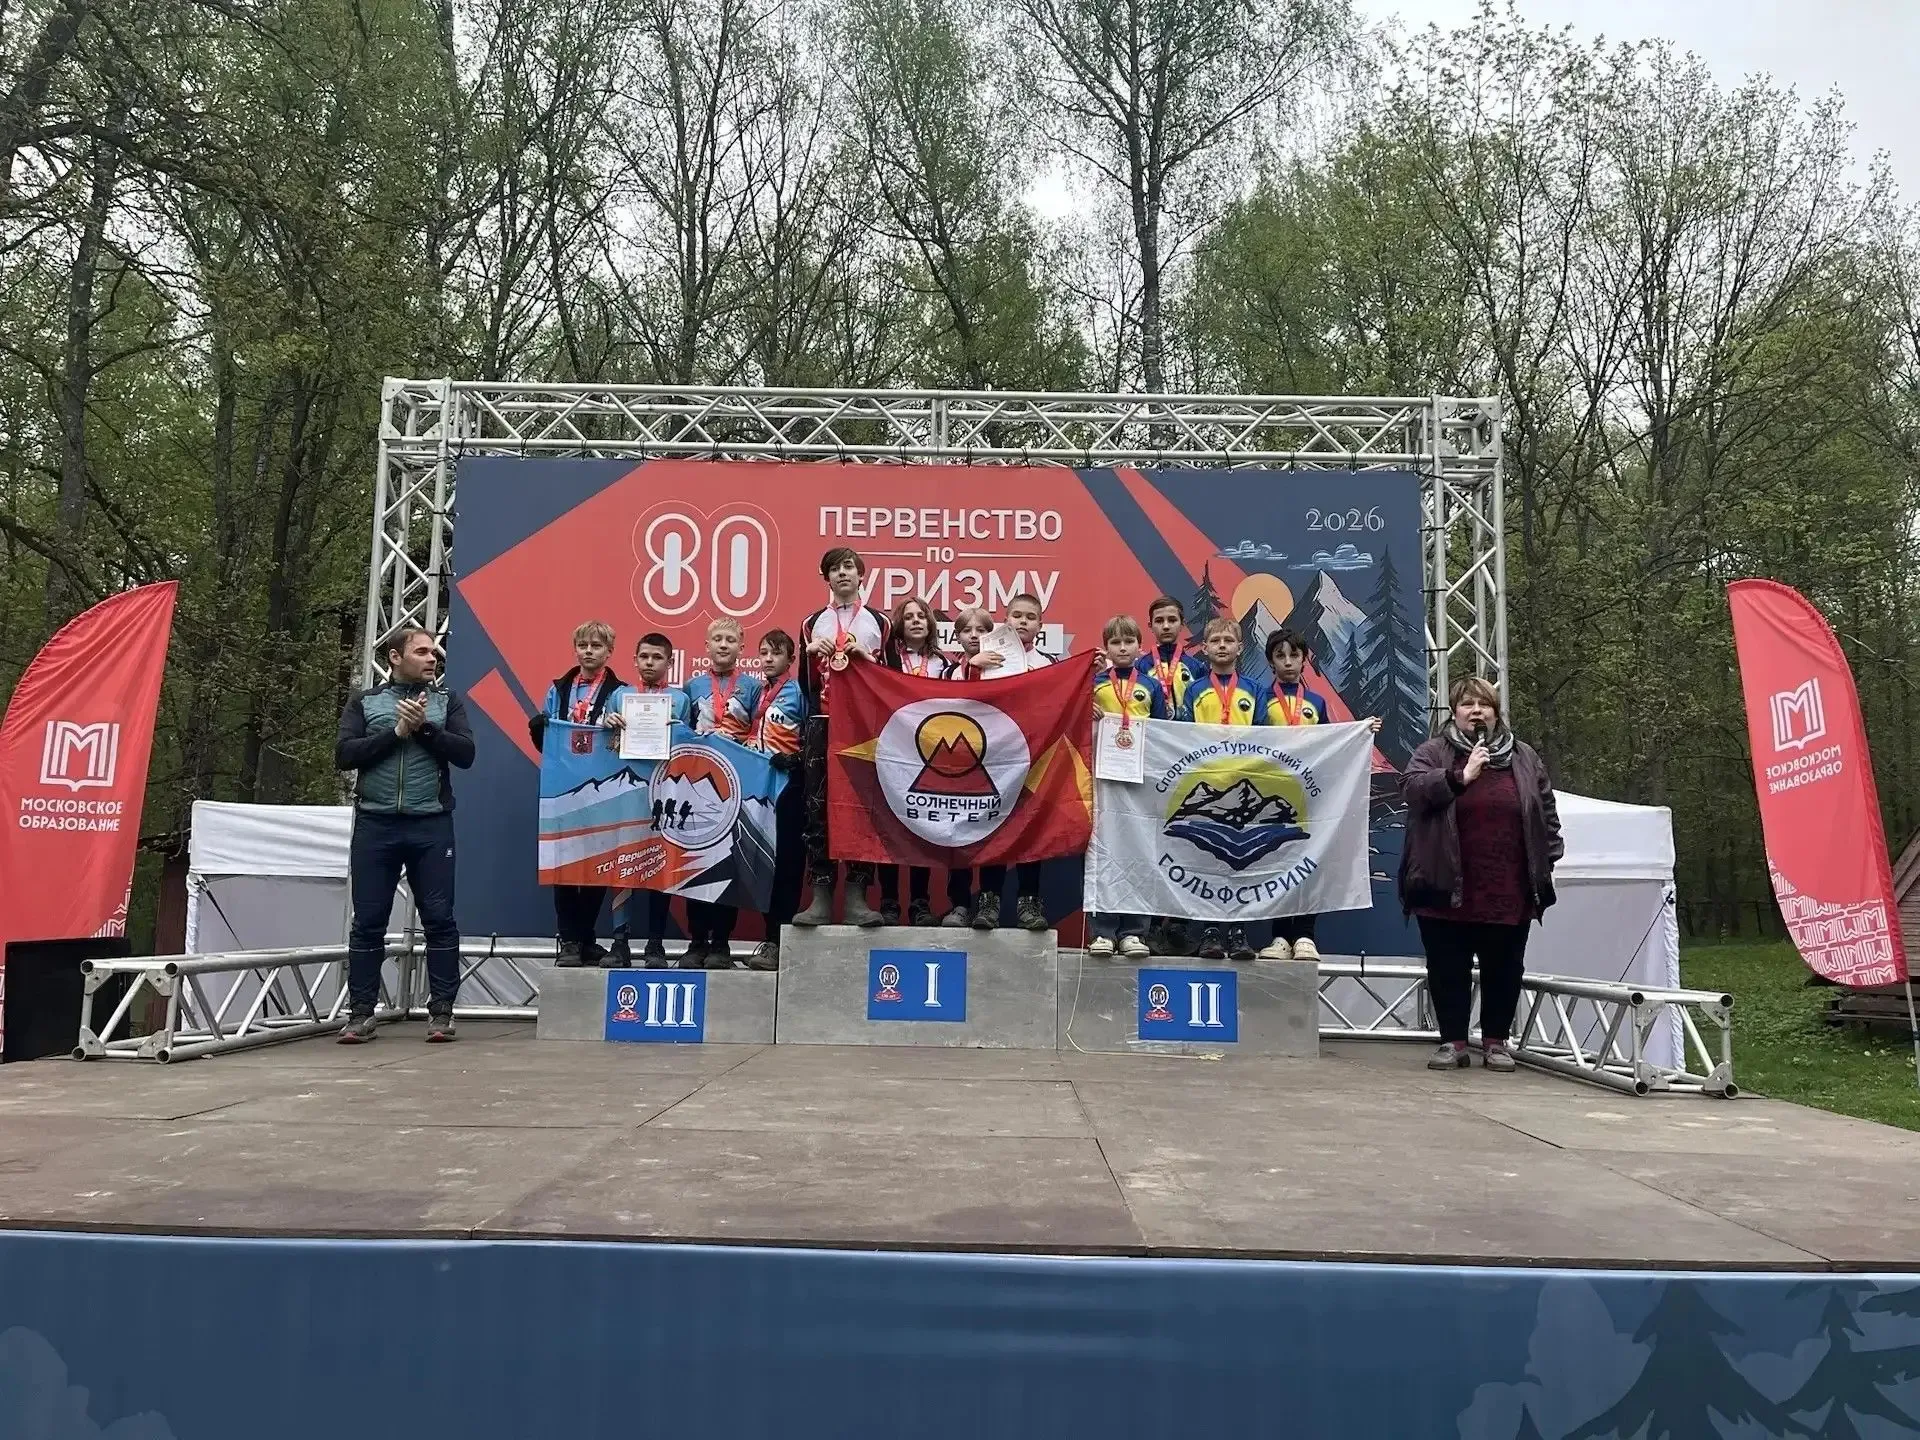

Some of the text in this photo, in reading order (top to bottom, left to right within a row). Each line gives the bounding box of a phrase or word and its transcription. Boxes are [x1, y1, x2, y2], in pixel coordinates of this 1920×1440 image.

[819, 506, 1062, 540] ПЕРВЕНСТВО
[1305, 506, 1385, 531] 2026
[643, 512, 769, 616] 80
[926, 547, 955, 563] ПО
[819, 567, 1060, 613] УРИЗМУ
[1155, 740, 1302, 793] Спортивно-Туристский
[1301, 767, 1321, 797] Клуб
[20, 798, 123, 815] МОСКОВСКОЕ
[905, 795, 1001, 810] СОЛНЕЧНЫЙ
[906, 808, 1000, 822] ВЕТЕР
[19, 815, 120, 832] ОБРАЗОВАНИЕ
[1159, 852, 1319, 904] ГОЛЬФСТРИМ
[643, 982, 698, 1028] III
[923, 963, 942, 1008] I
[1187, 982, 1225, 1028] II
